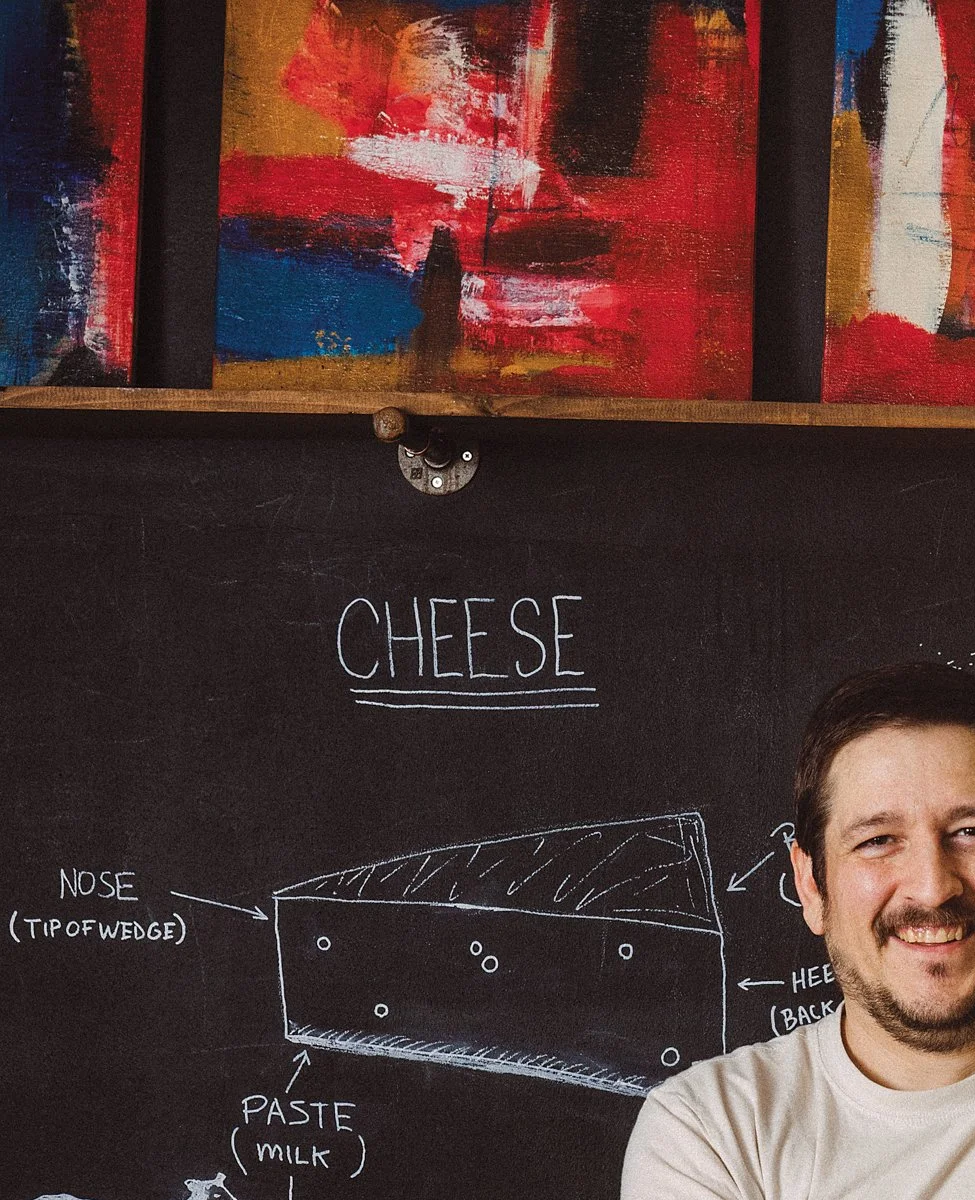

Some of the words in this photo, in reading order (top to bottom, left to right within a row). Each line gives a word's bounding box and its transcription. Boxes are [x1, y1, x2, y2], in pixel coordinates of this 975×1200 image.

[337, 596, 585, 679] CHEESE
[60, 868, 138, 900] NOSE
[792, 963, 836, 993] HEE
[242, 1094, 356, 1131] PASTE
